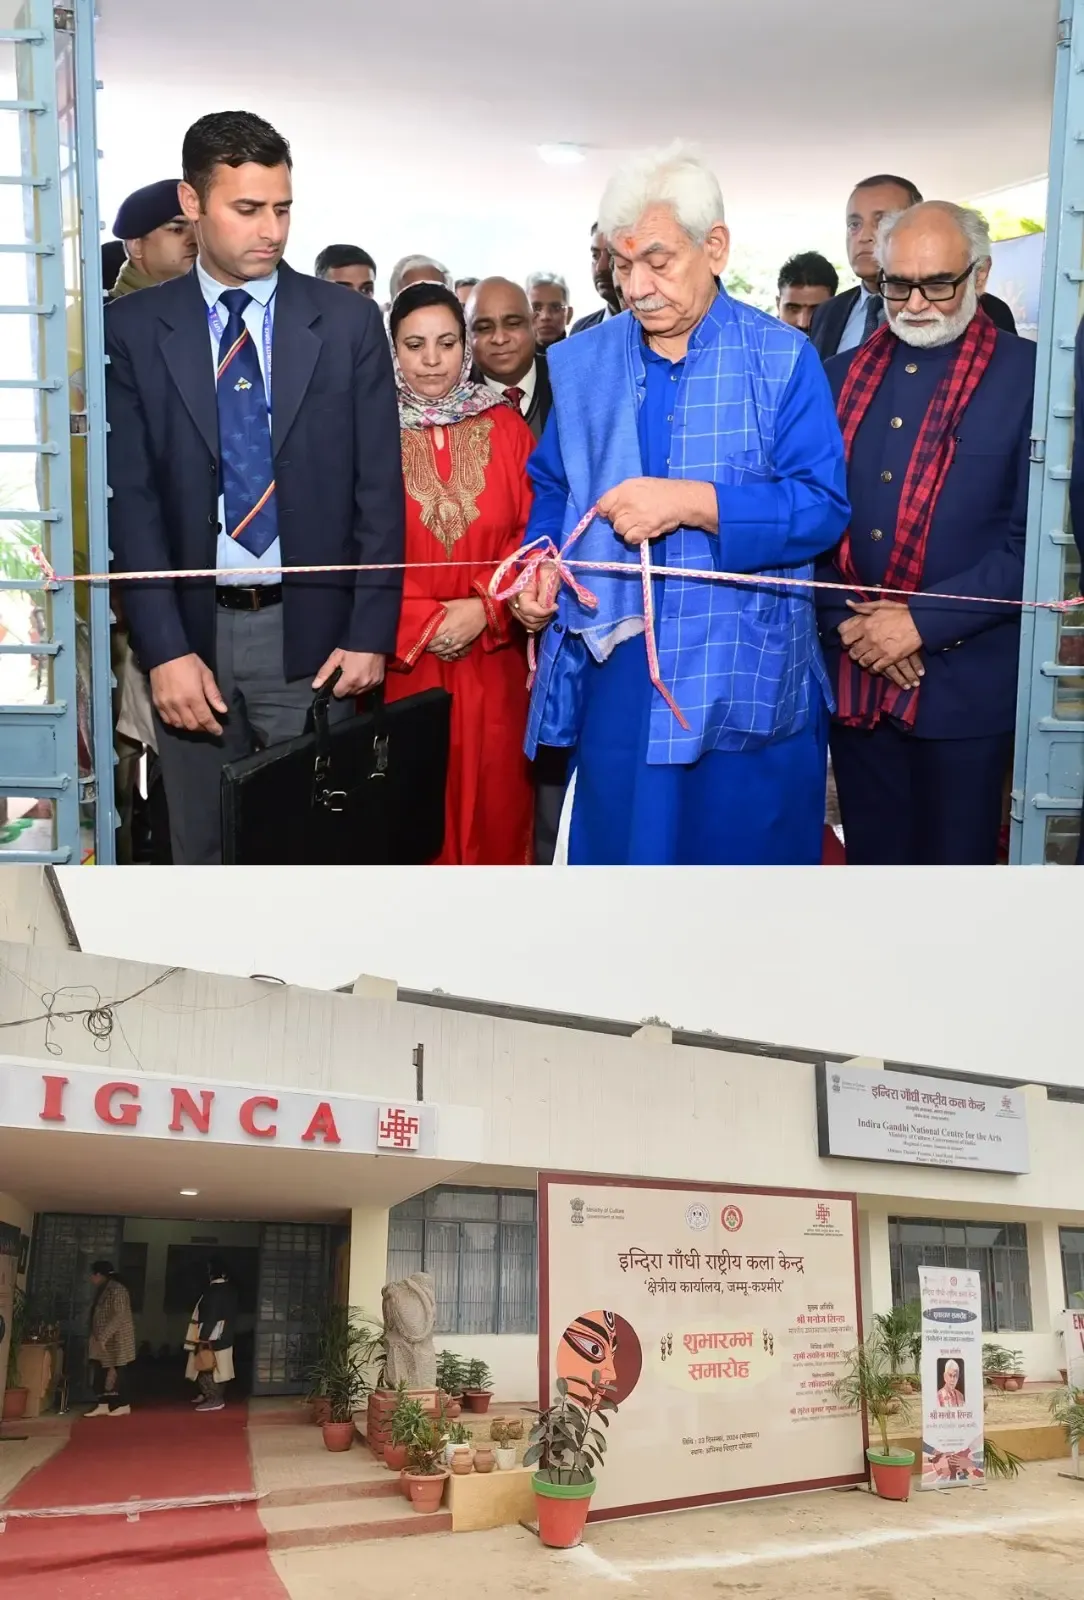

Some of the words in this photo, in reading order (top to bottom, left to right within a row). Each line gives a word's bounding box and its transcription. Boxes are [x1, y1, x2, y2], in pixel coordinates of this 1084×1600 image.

[38, 1075, 342, 1144] IGNCA
[871, 1084, 899, 1100] इन्दिरा
[921, 1092, 947, 1108] राष्ट्रीय
[948, 1096, 966, 1109] कला
[968, 1096, 986, 1112] केन्द्र
[857, 1118, 881, 1129] Indira
[882, 1120, 909, 1132] Gandhi
[911, 1124, 940, 1136] National
[941, 1128, 963, 1138] Centre
[965, 1130, 975, 1139] for
[976, 1131, 986, 1141] the
[988, 1133, 1002, 1142] Arts
[618, 1247, 663, 1272] इन्दिरा
[667, 1248, 701, 1270] गाँधी
[704, 1248, 742, 1275] राष्ट्रीय
[746, 1255, 775, 1270] कला
[778, 1250, 804, 1274] केन्द्र
[680, 1278, 724, 1294] कार्यालय,
[796, 1314, 805, 1324] श्री
[806, 1314, 826, 1323] मनोज
[827, 1314, 845, 1323] सिन्हा
[683, 1332, 754, 1355] शुभारम्भ
[688, 1357, 751, 1380] समारोह
